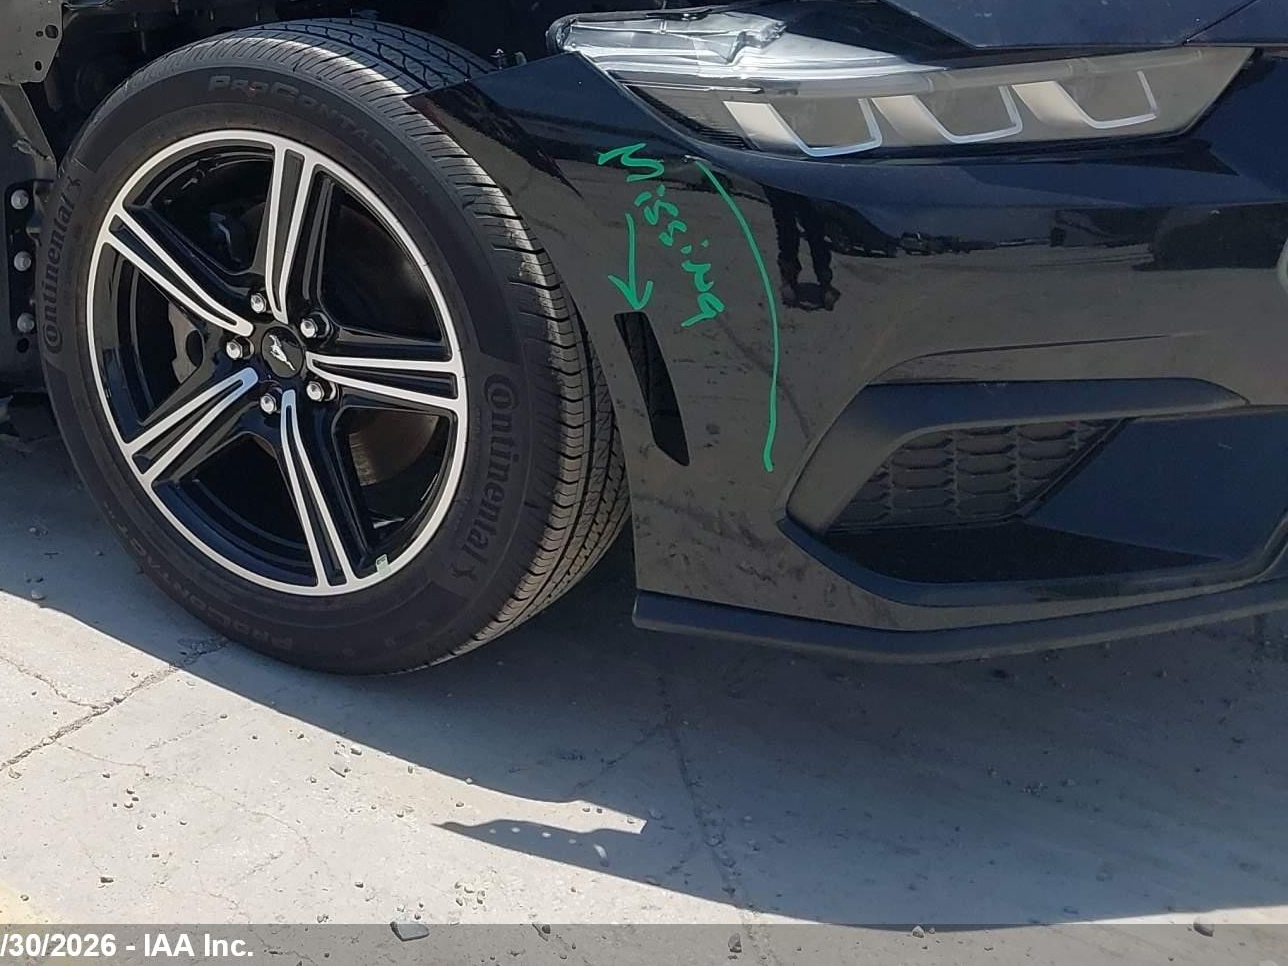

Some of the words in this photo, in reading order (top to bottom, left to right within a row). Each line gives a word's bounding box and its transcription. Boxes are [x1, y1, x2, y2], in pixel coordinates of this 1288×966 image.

[41, 195, 75, 354] Continental
[598, 142, 726, 327] Missing
[462, 374, 520, 563] Continental
